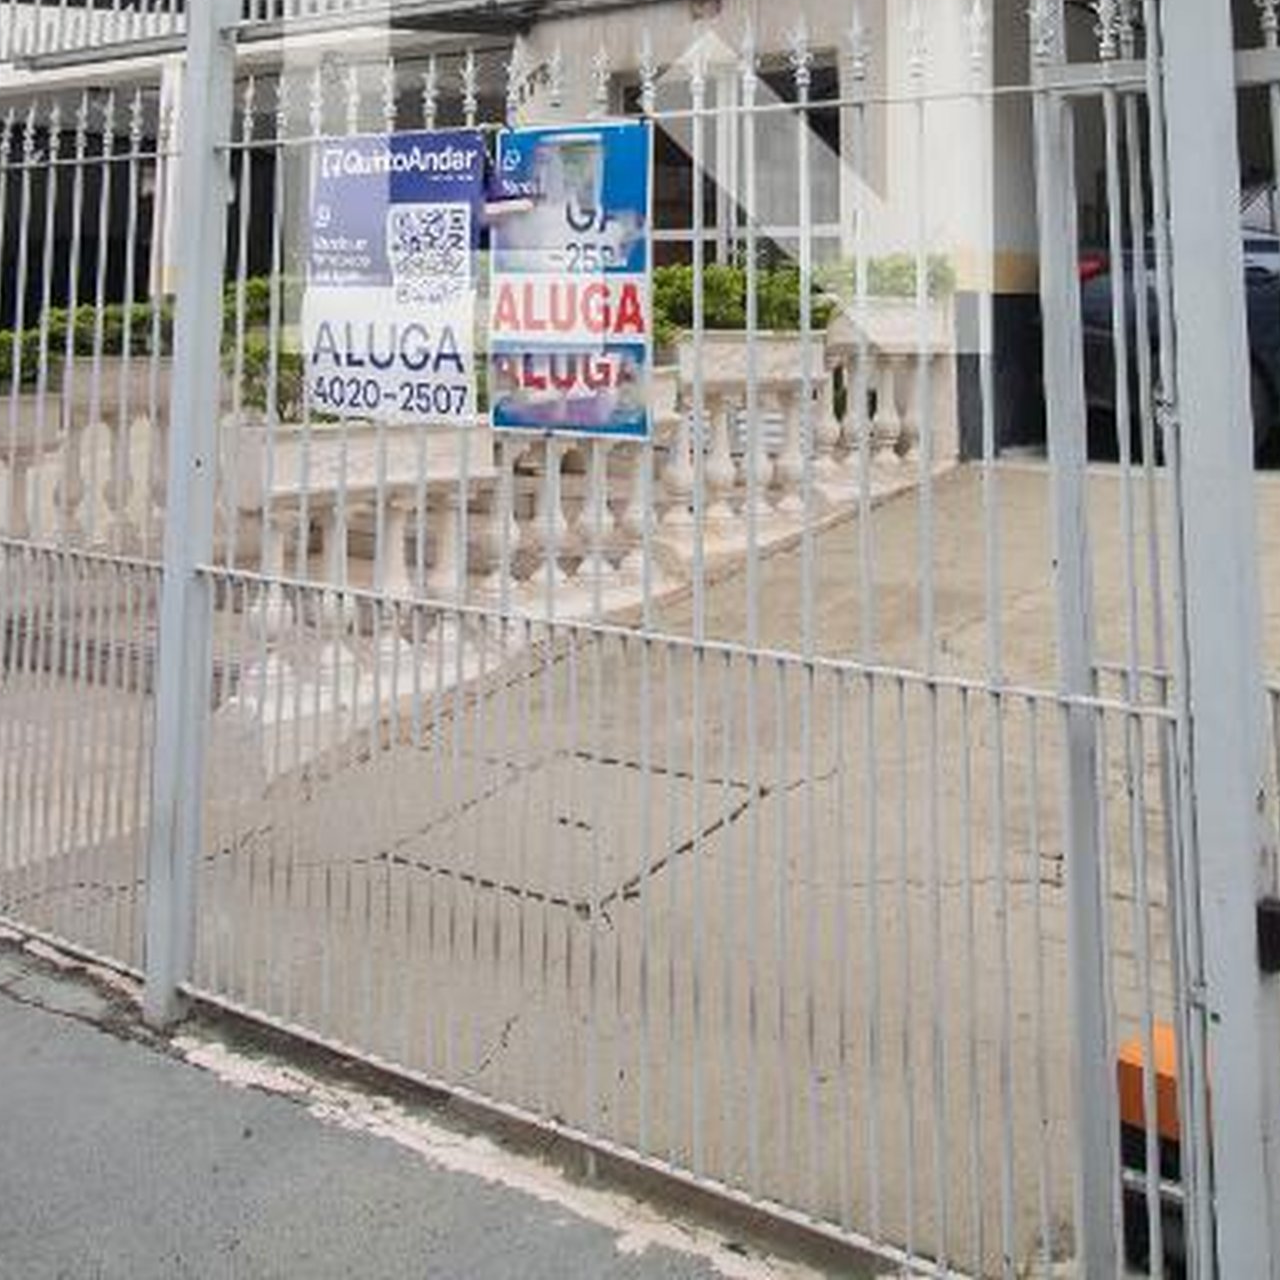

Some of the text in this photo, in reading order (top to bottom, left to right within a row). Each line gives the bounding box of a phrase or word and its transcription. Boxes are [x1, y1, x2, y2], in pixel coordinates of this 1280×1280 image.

[494, 282, 644, 333] ALUGA
[312, 321, 464, 373] ALUGA
[314, 376, 468, 415] 4020-2507
